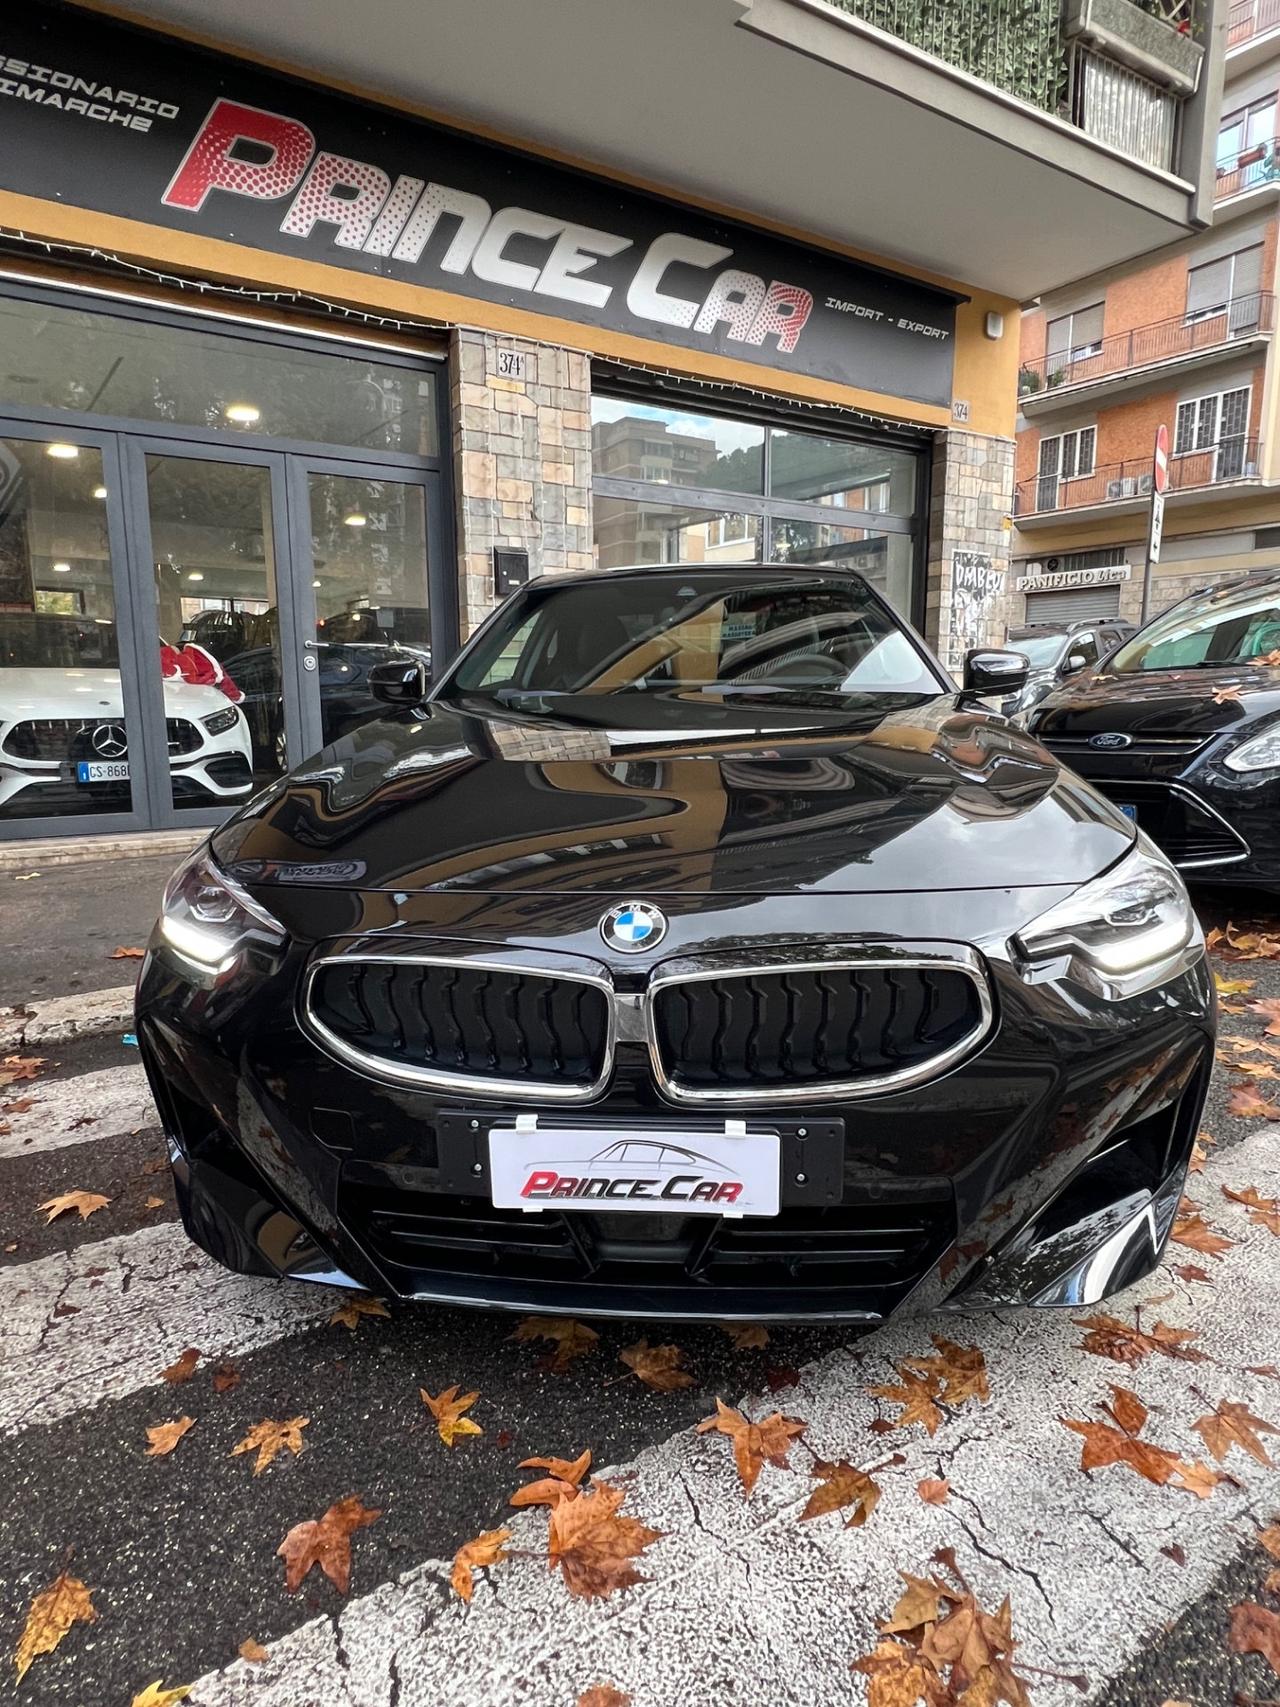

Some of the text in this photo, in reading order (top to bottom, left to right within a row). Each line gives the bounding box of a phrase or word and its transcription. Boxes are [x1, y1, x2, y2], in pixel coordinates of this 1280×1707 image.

[626, 232, 814, 354] CAR
[825, 297, 884, 321] IMPORT
[897, 318, 949, 340] EXPORT
[953, 402, 968, 420] 374
[1020, 570, 1095, 591] PANIFICIO
[660, 1175, 744, 1204] CAR
